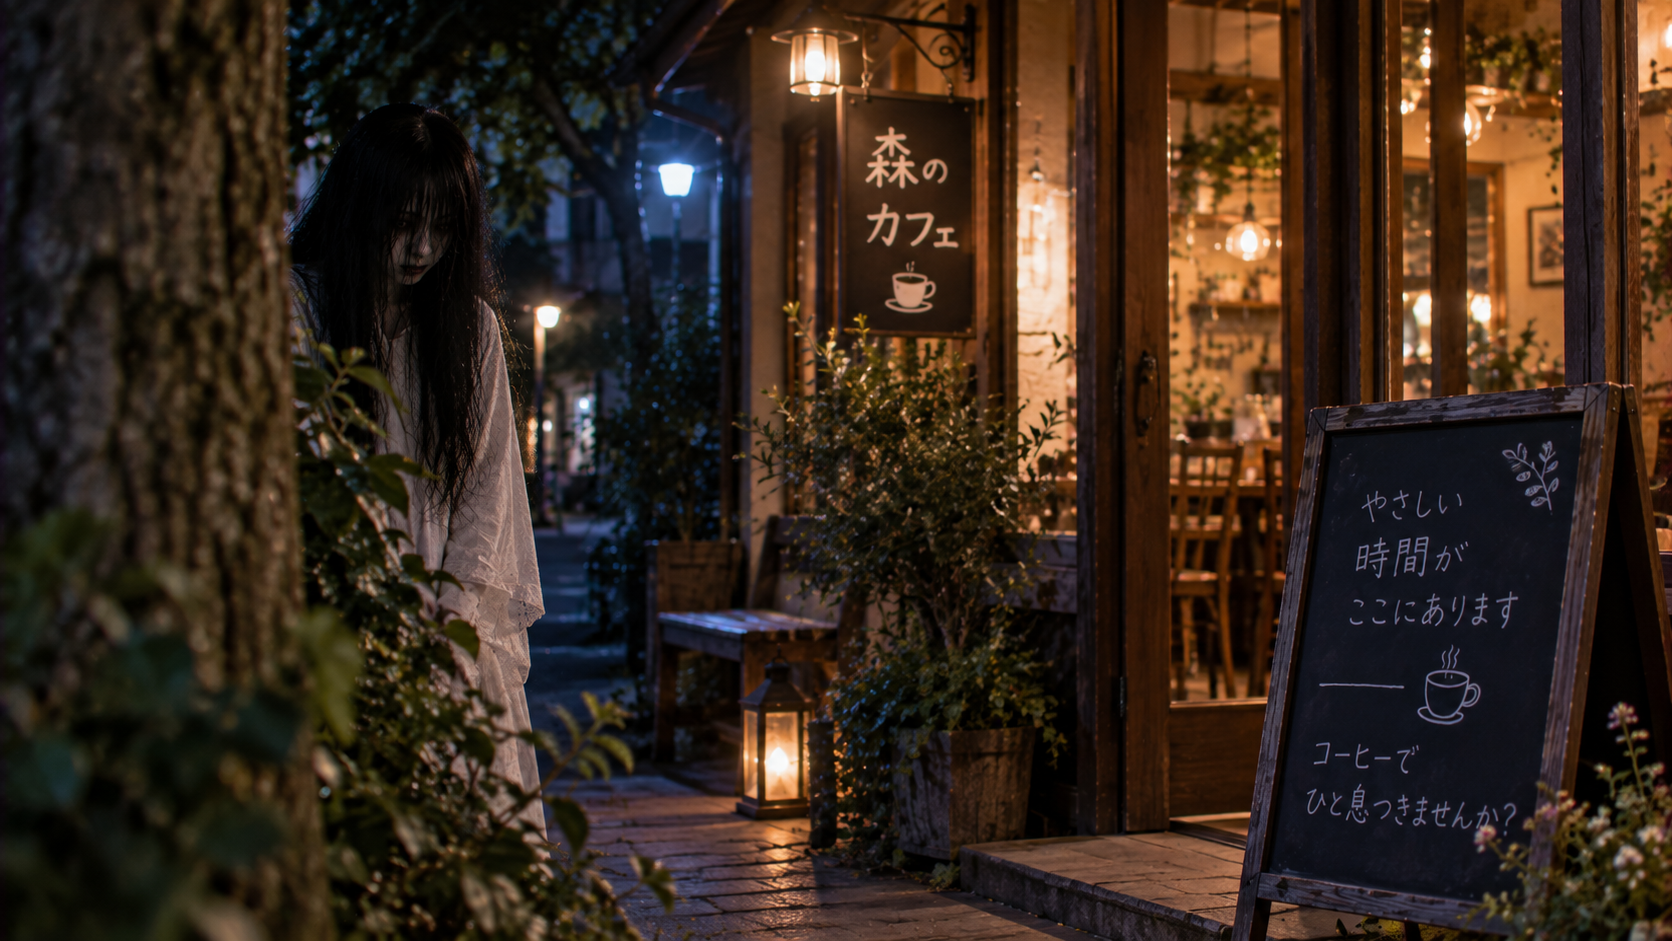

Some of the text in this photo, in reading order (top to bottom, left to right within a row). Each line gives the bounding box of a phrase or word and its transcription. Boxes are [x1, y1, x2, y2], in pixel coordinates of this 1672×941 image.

[865, 126, 948, 189] 森の
[867, 202, 959, 248] カフェ
[1361, 490, 1463, 523] やさしい
[1355, 536, 1469, 579] 時間が
[1349, 591, 1519, 629] ここにあります
[1313, 742, 1420, 774] コーヒーで
